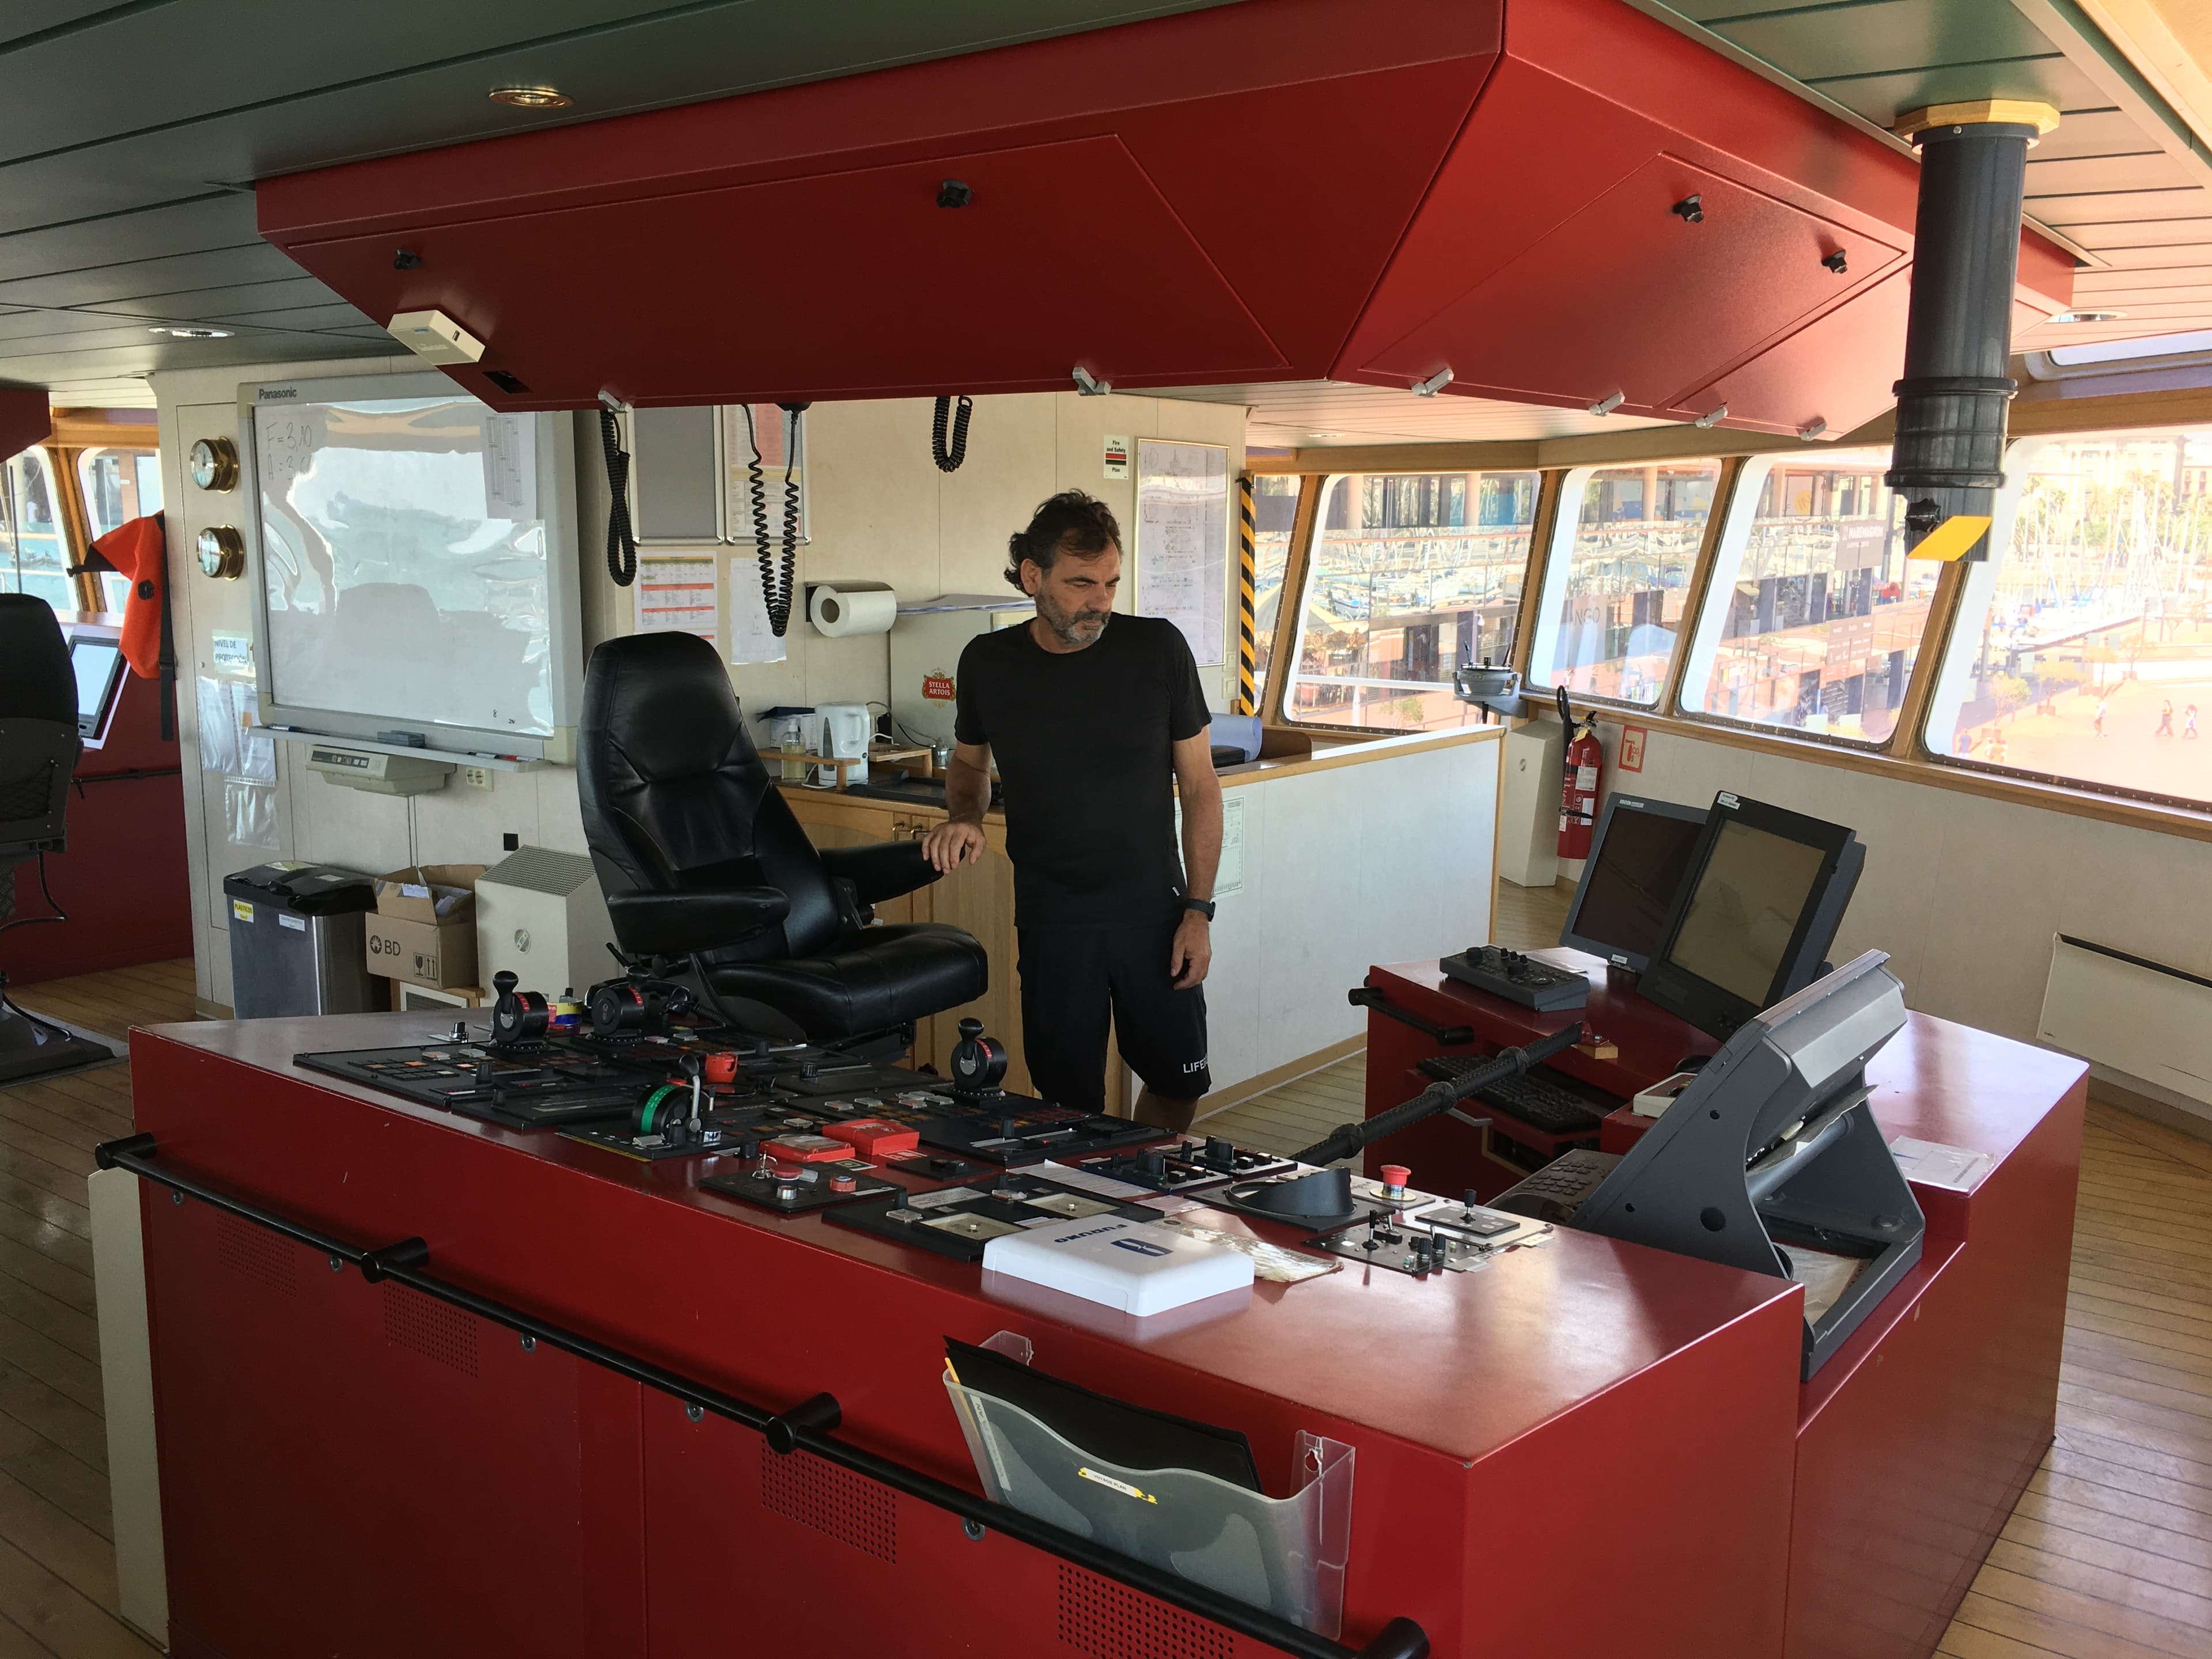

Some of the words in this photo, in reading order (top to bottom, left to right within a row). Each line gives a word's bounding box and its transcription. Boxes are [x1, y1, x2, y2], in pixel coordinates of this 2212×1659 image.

[259, 387, 297, 400] Panasonic
[215, 639, 229, 648] NIVEL
[230, 641, 237, 649] DE
[384, 940, 402, 956] BD
[1183, 1054, 1208, 1073] LIFE
[1054, 1224, 1128, 1244] FURUNO
[1113, 1482, 1127, 1491] PLAN
